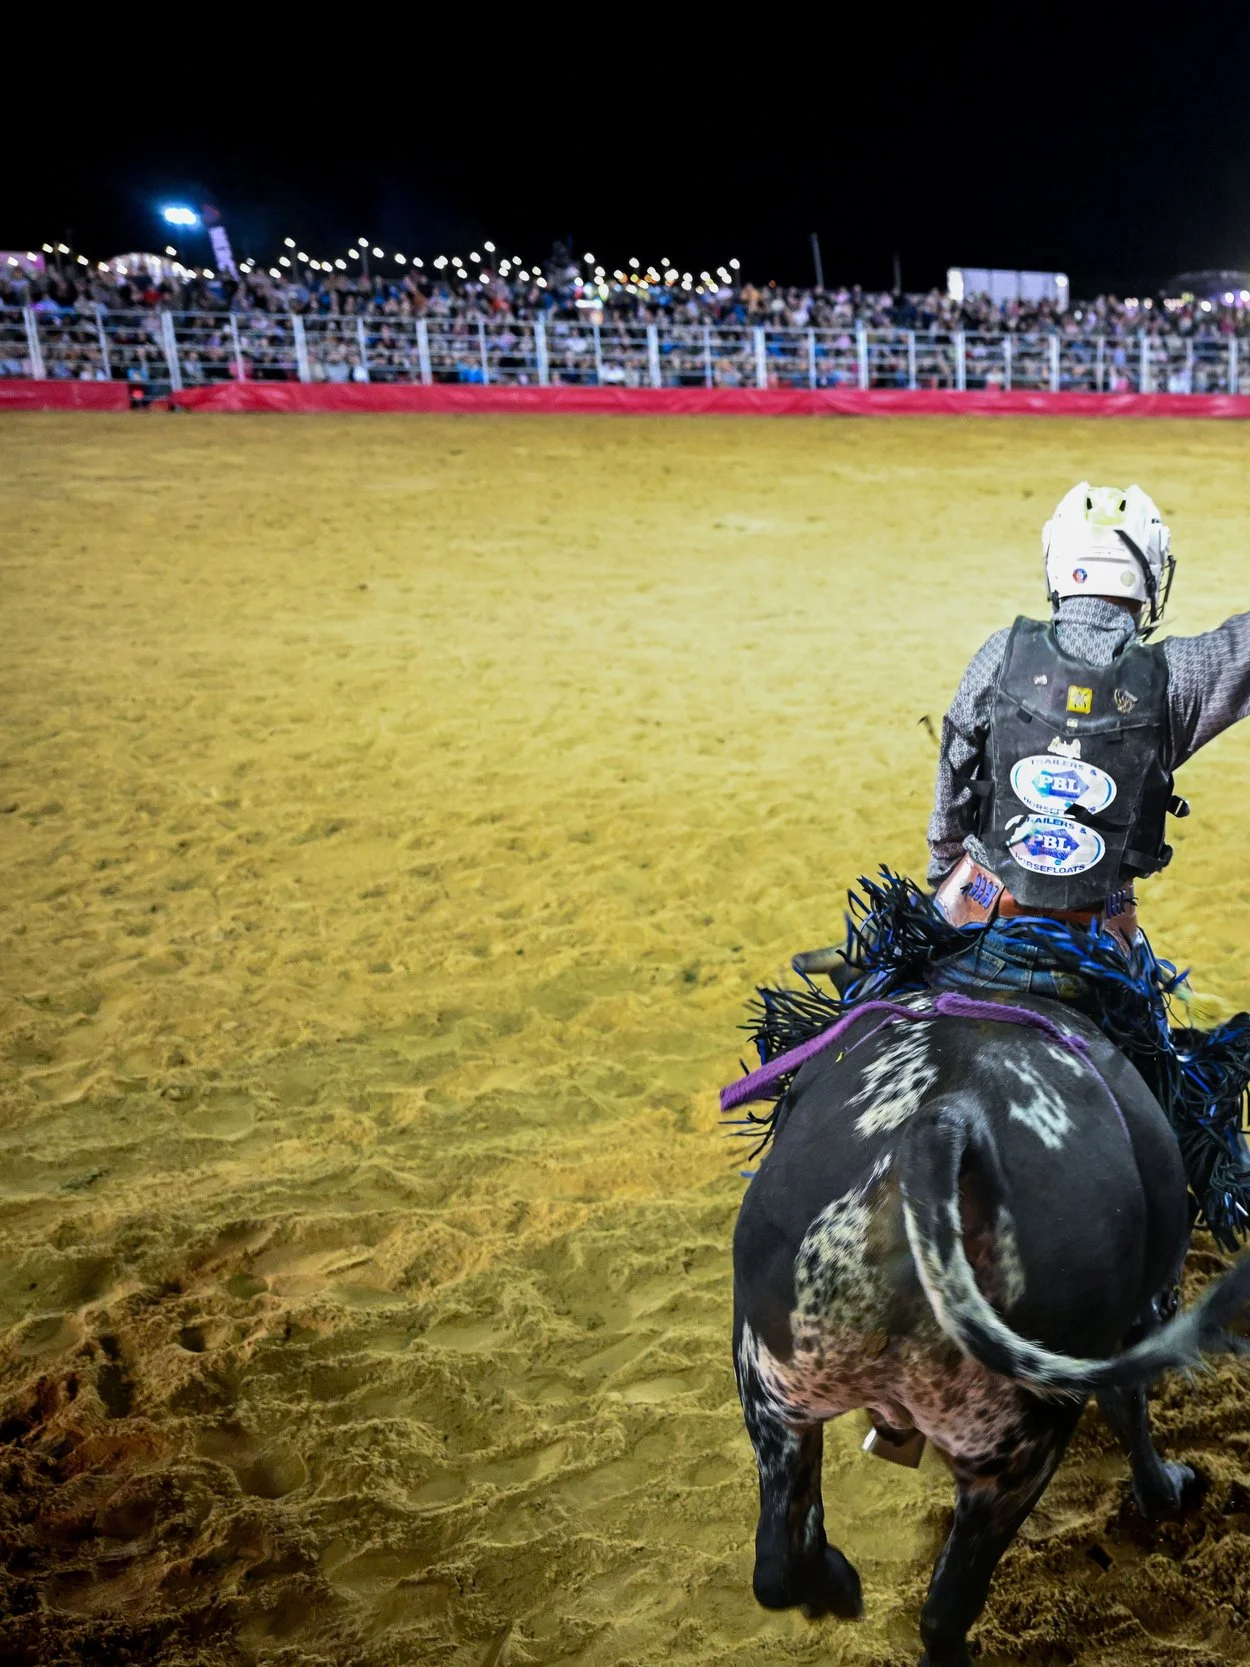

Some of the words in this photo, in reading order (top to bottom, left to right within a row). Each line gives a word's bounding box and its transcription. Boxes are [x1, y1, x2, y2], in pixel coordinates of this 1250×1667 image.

[1038, 774, 1081, 793] PBL
[1026, 816, 1075, 830] TAILERS
[1028, 833, 1071, 852] PBL
